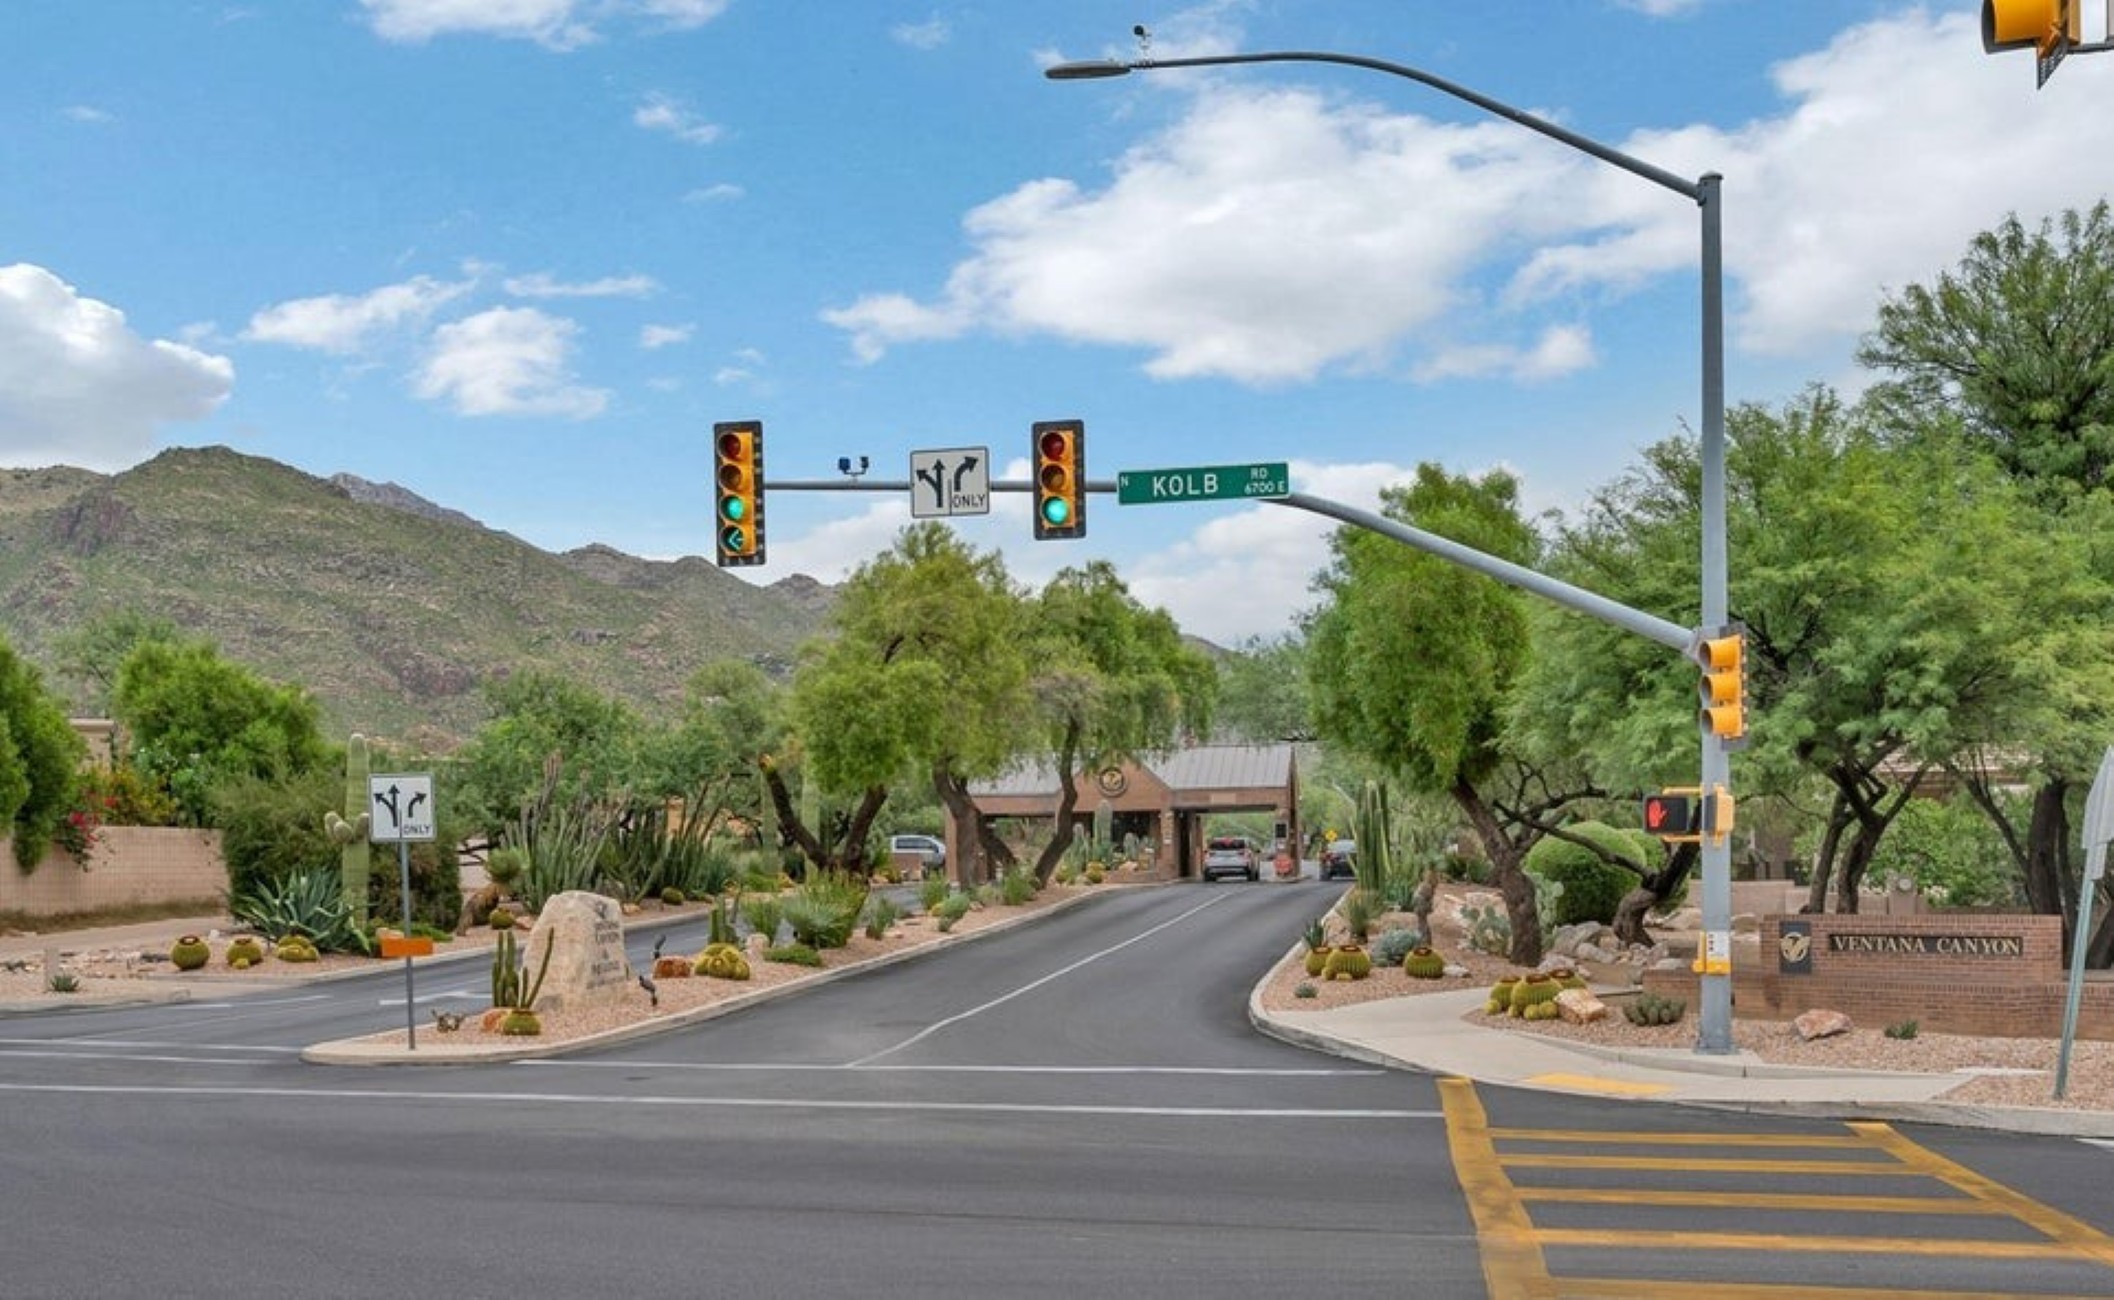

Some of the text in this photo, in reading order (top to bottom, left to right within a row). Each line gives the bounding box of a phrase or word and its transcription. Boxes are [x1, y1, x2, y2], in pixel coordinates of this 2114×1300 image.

[1120, 467, 1269, 497] N KOLB RD
[1244, 481, 1286, 494] 6700 E
[952, 494, 985, 508] ONLY
[403, 824, 431, 835] ONLY
[1834, 936, 2020, 955] VENTANA CANYON
